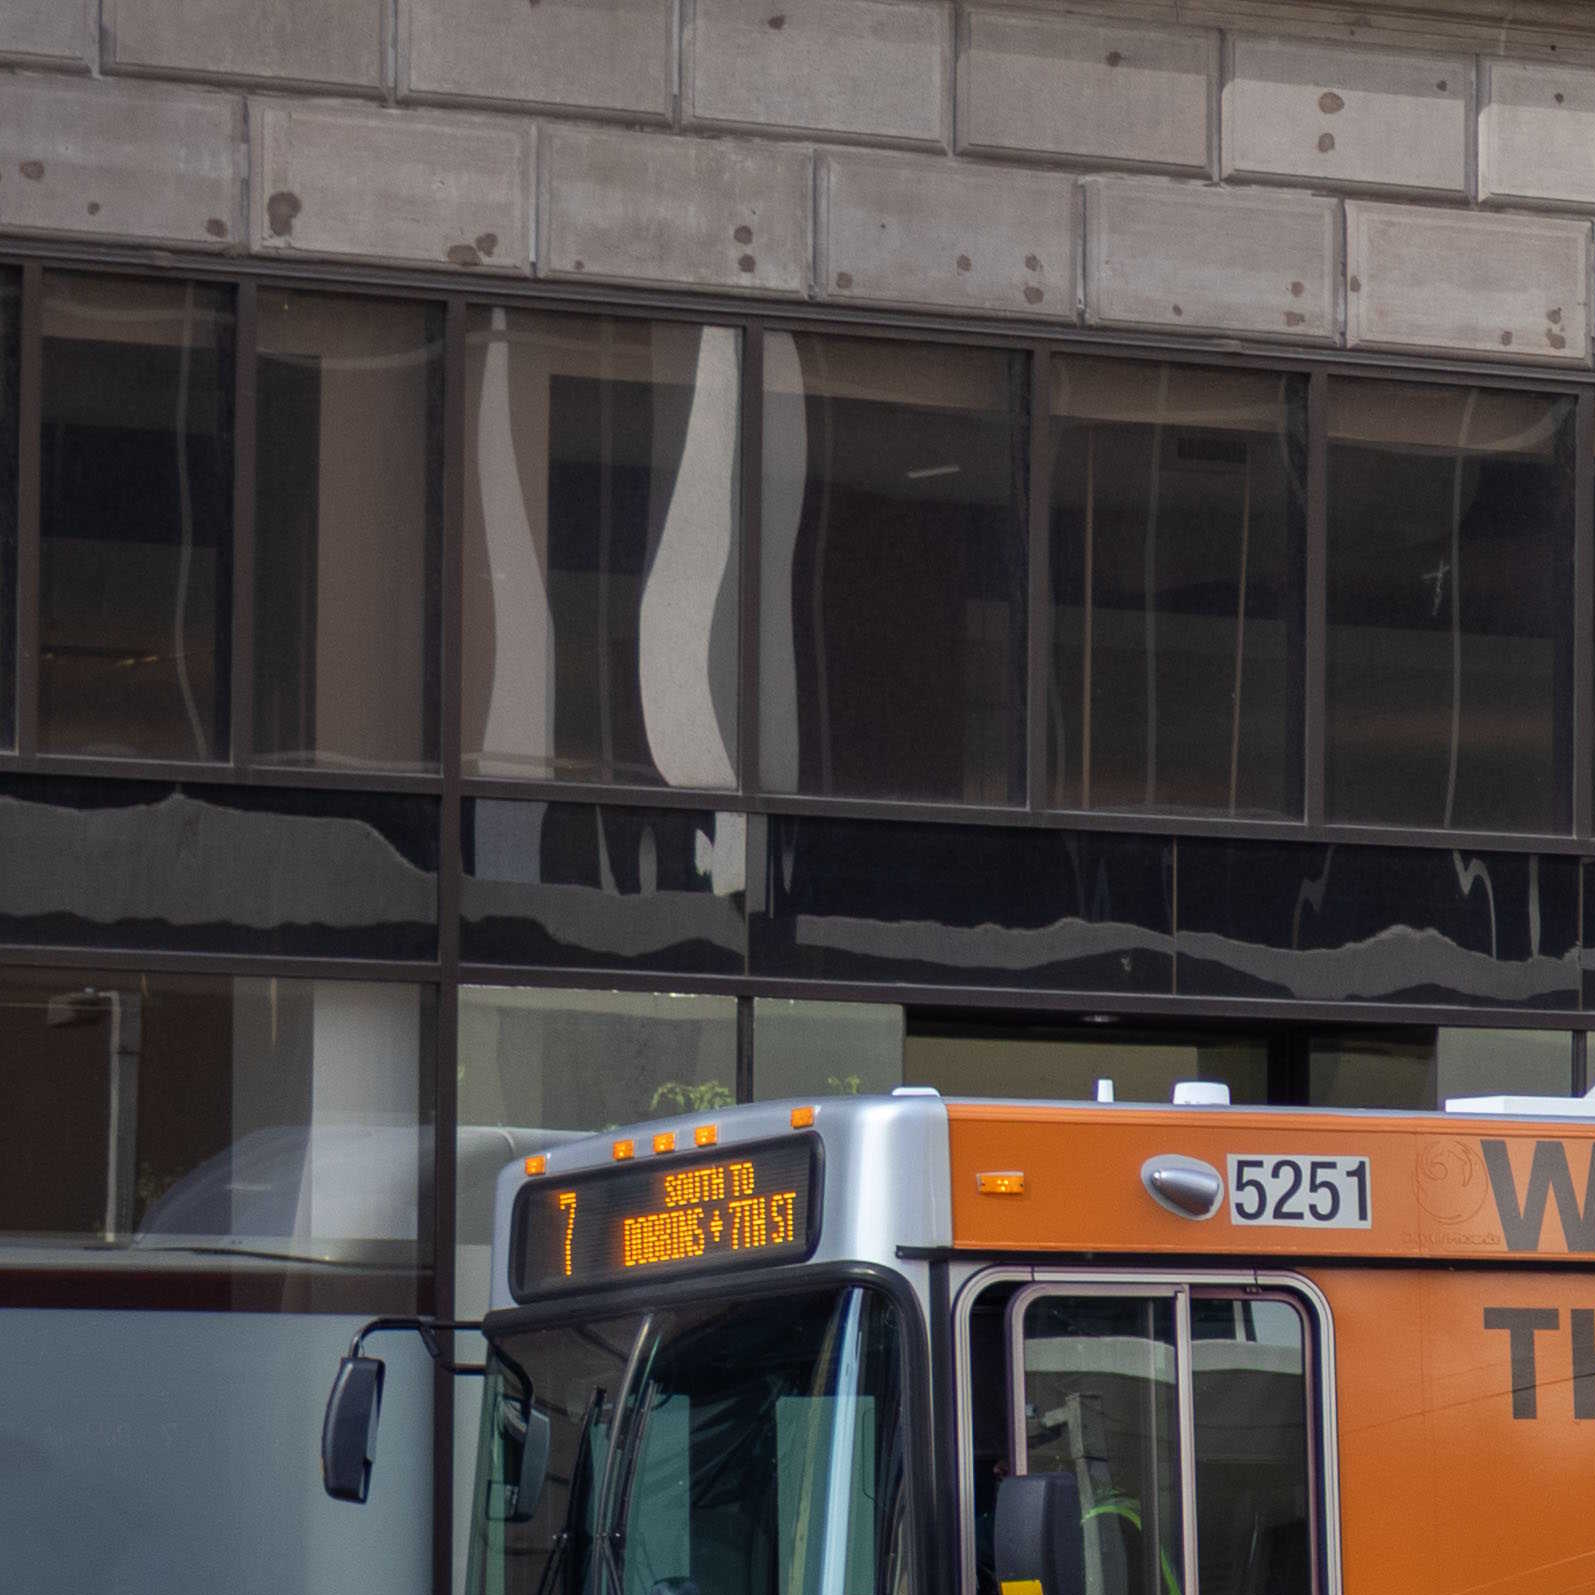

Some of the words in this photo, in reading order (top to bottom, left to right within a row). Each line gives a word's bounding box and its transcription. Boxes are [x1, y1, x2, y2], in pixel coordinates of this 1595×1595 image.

[664, 1167, 725, 1207] SOUTH
[728, 1162, 755, 1196] TO
[1234, 1158, 1370, 1222] 5251
[558, 1191, 577, 1276] 7
[623, 1207, 705, 1267] DOBBINS
[728, 1197, 766, 1250] 7TH
[770, 1191, 797, 1244] ST
